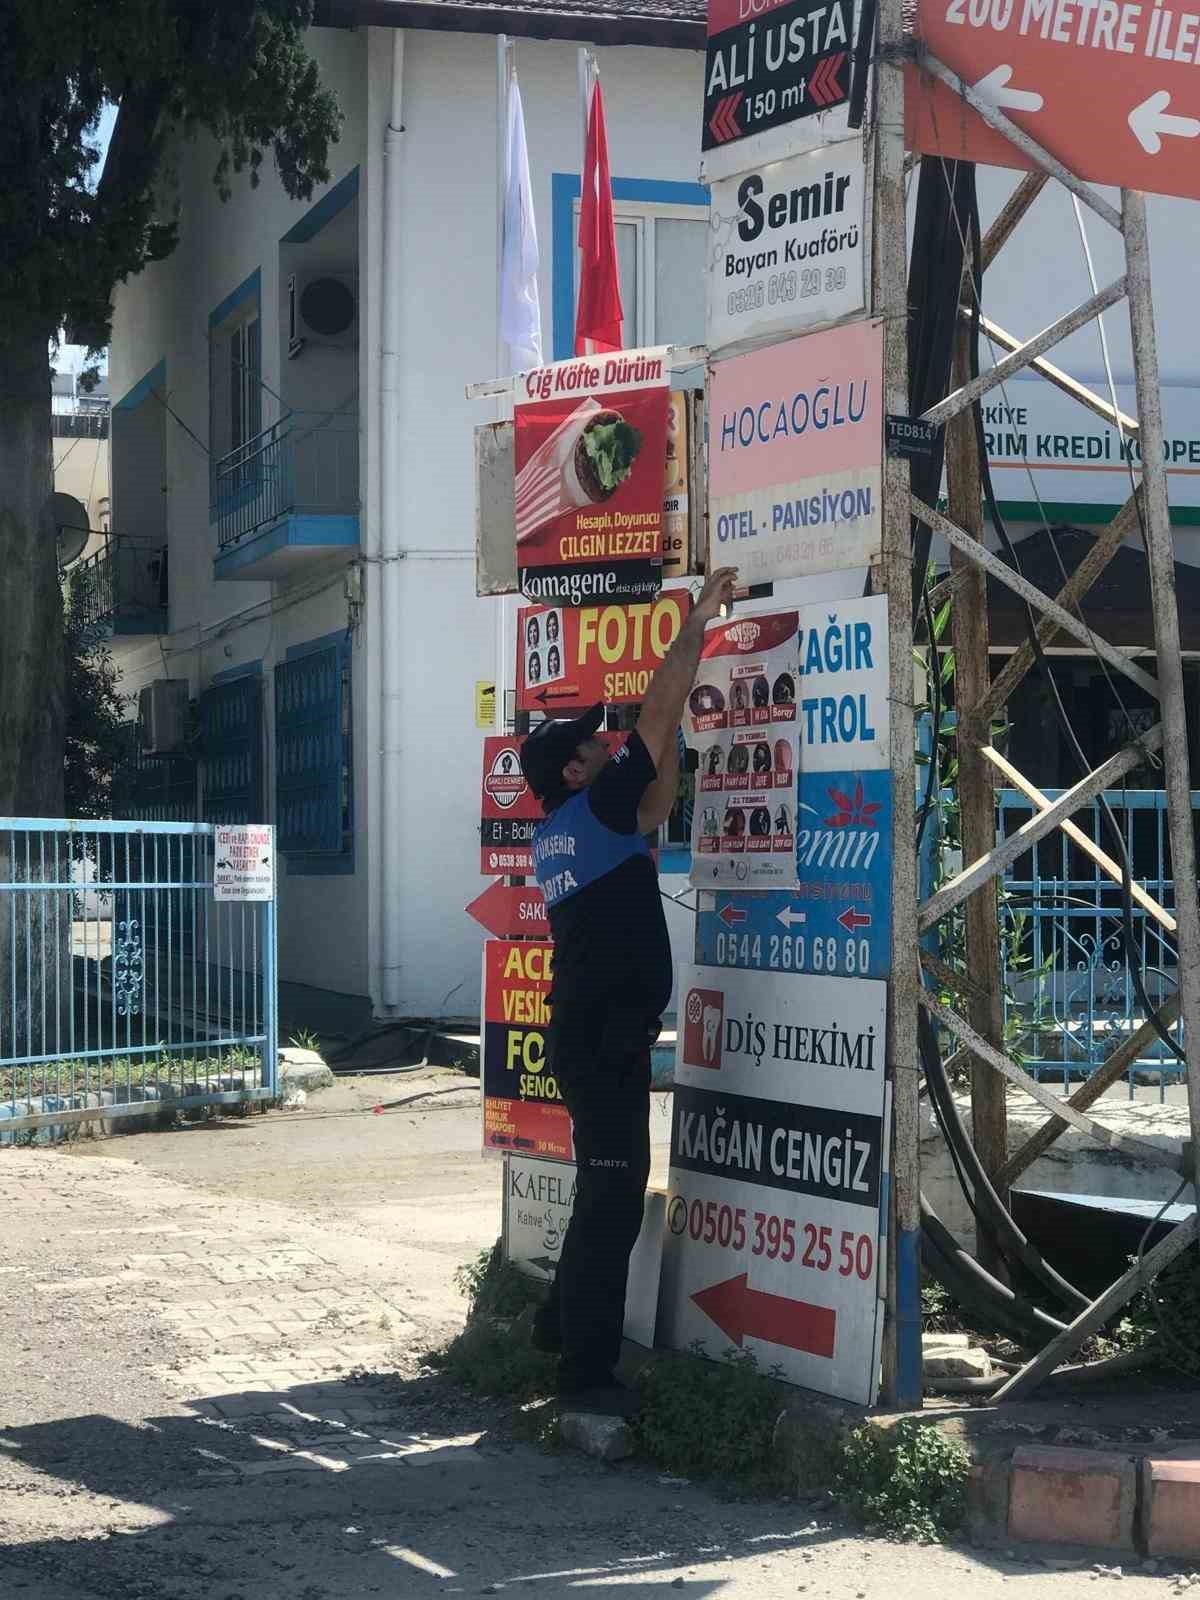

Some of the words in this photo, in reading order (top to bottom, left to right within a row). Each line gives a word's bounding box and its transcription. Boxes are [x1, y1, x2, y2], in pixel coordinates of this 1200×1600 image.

[706, 23, 755, 97] ALİ
[765, 1, 848, 72] USTA
[945, 0, 1011, 31] 200
[1019, 0, 1142, 53] METRE
[1144, 0, 1200, 65] İLE
[744, 88, 776, 124] 150
[781, 77, 808, 113] mt
[737, 171, 851, 243] Semir
[725, 247, 778, 278] Bayan
[784, 224, 859, 265] Kuaförü
[767, 270, 797, 305] 643
[800, 268, 822, 298] 29
[824, 266, 847, 292] 39
[526, 370, 552, 400] Çiğ
[555, 363, 600, 392] Köfte
[604, 357, 662, 385] Dürüm
[721, 376, 867, 452] HOCAOĞLU
[889, 422, 932, 441] TED814
[1036, 430, 1111, 460] KREDİ
[614, 512, 660, 530] Doyurucu
[717, 510, 757, 543] OTEL
[559, 535, 605, 561] ÇILGIN
[608, 531, 660, 556] LEZZET
[521, 567, 617, 606] komagene
[578, 598, 681, 665] FOTO
[798, 613, 874, 676] AĞIR
[604, 670, 654, 703] ŞENO
[492, 822, 503, 840] Et
[716, 932, 762, 966] 0544
[769, 935, 806, 969] 260
[813, 937, 837, 971] 68
[846, 938, 870, 974] 80
[725, 1012, 767, 1066] DİŞ
[772, 1022, 876, 1072] HEKİMİ
[677, 1105, 763, 1172] KAĞAN
[769, 1128, 871, 1193] CENGİZ
[517, 1208, 542, 1228] Kahve
[688, 1198, 747, 1252] 0505
[751, 1211, 796, 1262] 395
[801, 1222, 833, 1272] 25
[838, 1231, 874, 1281] 50
